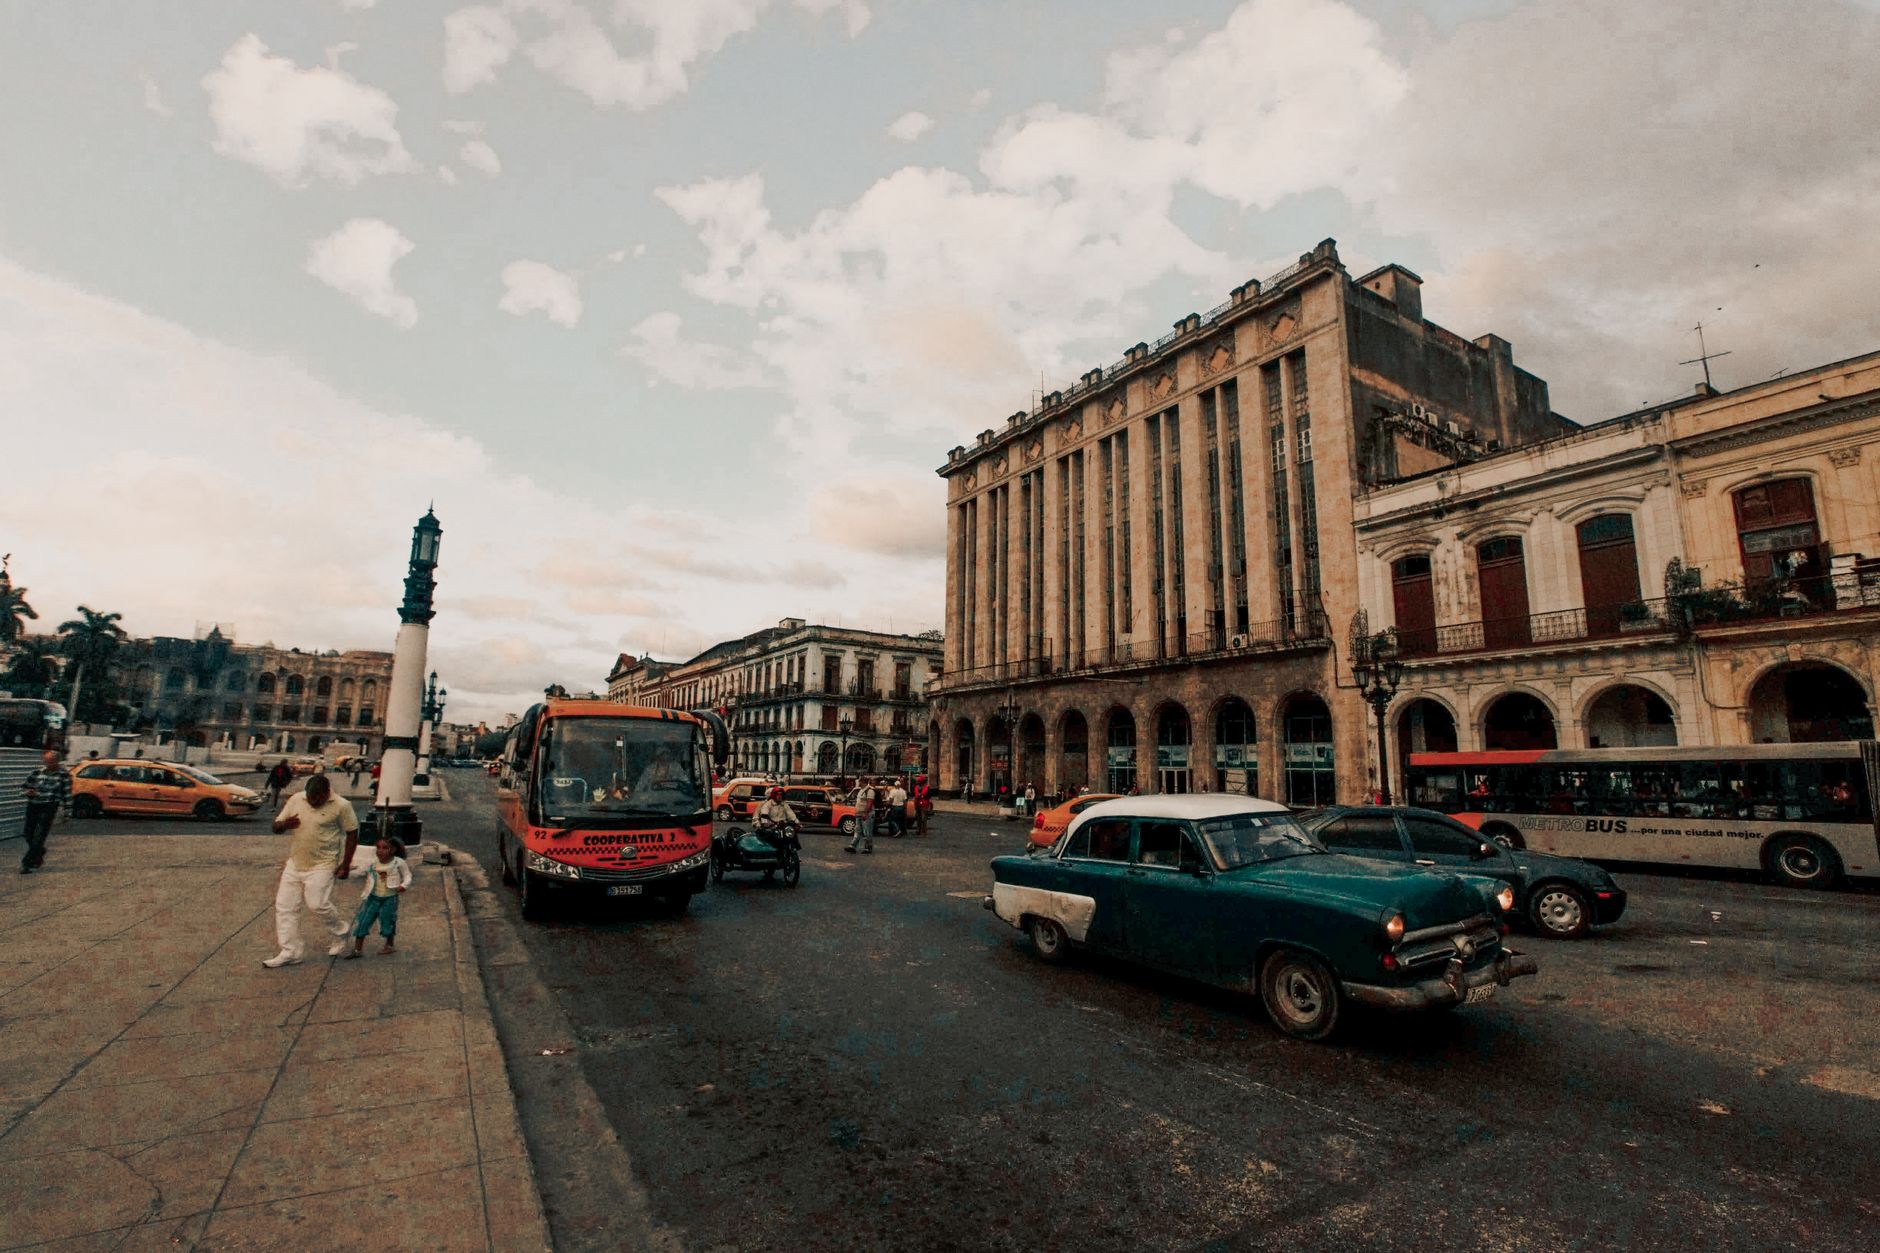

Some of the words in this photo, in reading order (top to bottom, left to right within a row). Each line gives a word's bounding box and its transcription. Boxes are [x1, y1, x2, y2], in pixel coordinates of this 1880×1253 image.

[1519, 817, 1628, 833] METROBUS
[1685, 829, 1723, 838] ciudad
[534, 831, 547, 840] 92
[583, 833, 664, 846] COOPERATIVA
[670, 832, 676, 842] 2
